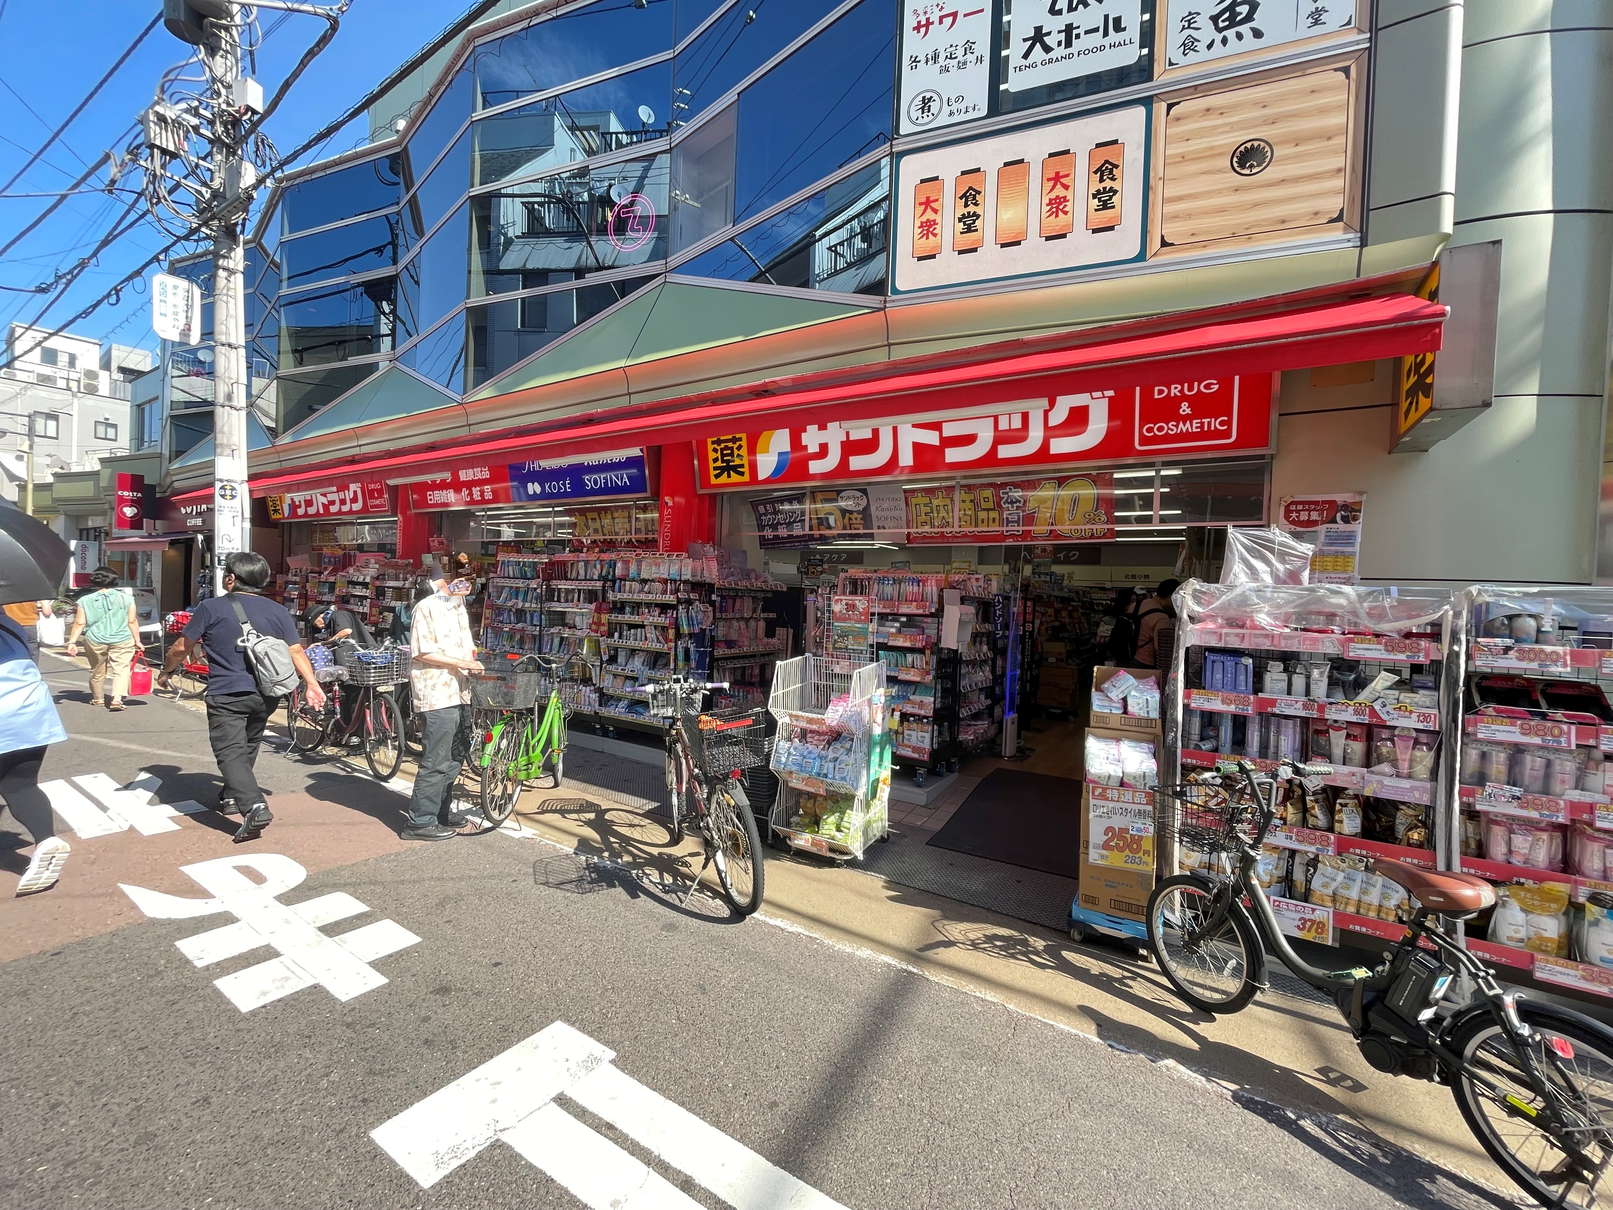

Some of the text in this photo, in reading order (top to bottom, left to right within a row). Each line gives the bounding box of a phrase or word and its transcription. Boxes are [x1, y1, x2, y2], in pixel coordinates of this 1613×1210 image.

[912, 8, 985, 40] サワー
[1021, 13, 1128, 61] 大ホール
[1177, 11, 1203, 57] 定食
[907, 40, 977, 71] 各種定食
[1013, 37, 1135, 74] TENG GRAND FOOD HALL
[915, 96, 936, 121] 煮
[946, 94, 964, 107] もの
[1045, 171, 1071, 219] 大衆
[1091, 159, 1120, 212] 食堂
[918, 196, 939, 240] 大衆
[957, 185, 982, 235] 食堂
[1154, 380, 1219, 398] DRUG
[1179, 402, 1192, 415] &
[711, 389, 1116, 480] 薬 サンドラッグ
[1143, 417, 1228, 436] COSMETIC
[462, 485, 493, 501] 化粧品
[545, 477, 572, 494] KOSÉ
[584, 473, 630, 490] SOFINA
[1001, 487, 1024, 535] 本日
[1415, 714, 1431, 724] 130
[1519, 722, 1563, 738] 980
[1296, 916, 1326, 936] 378
